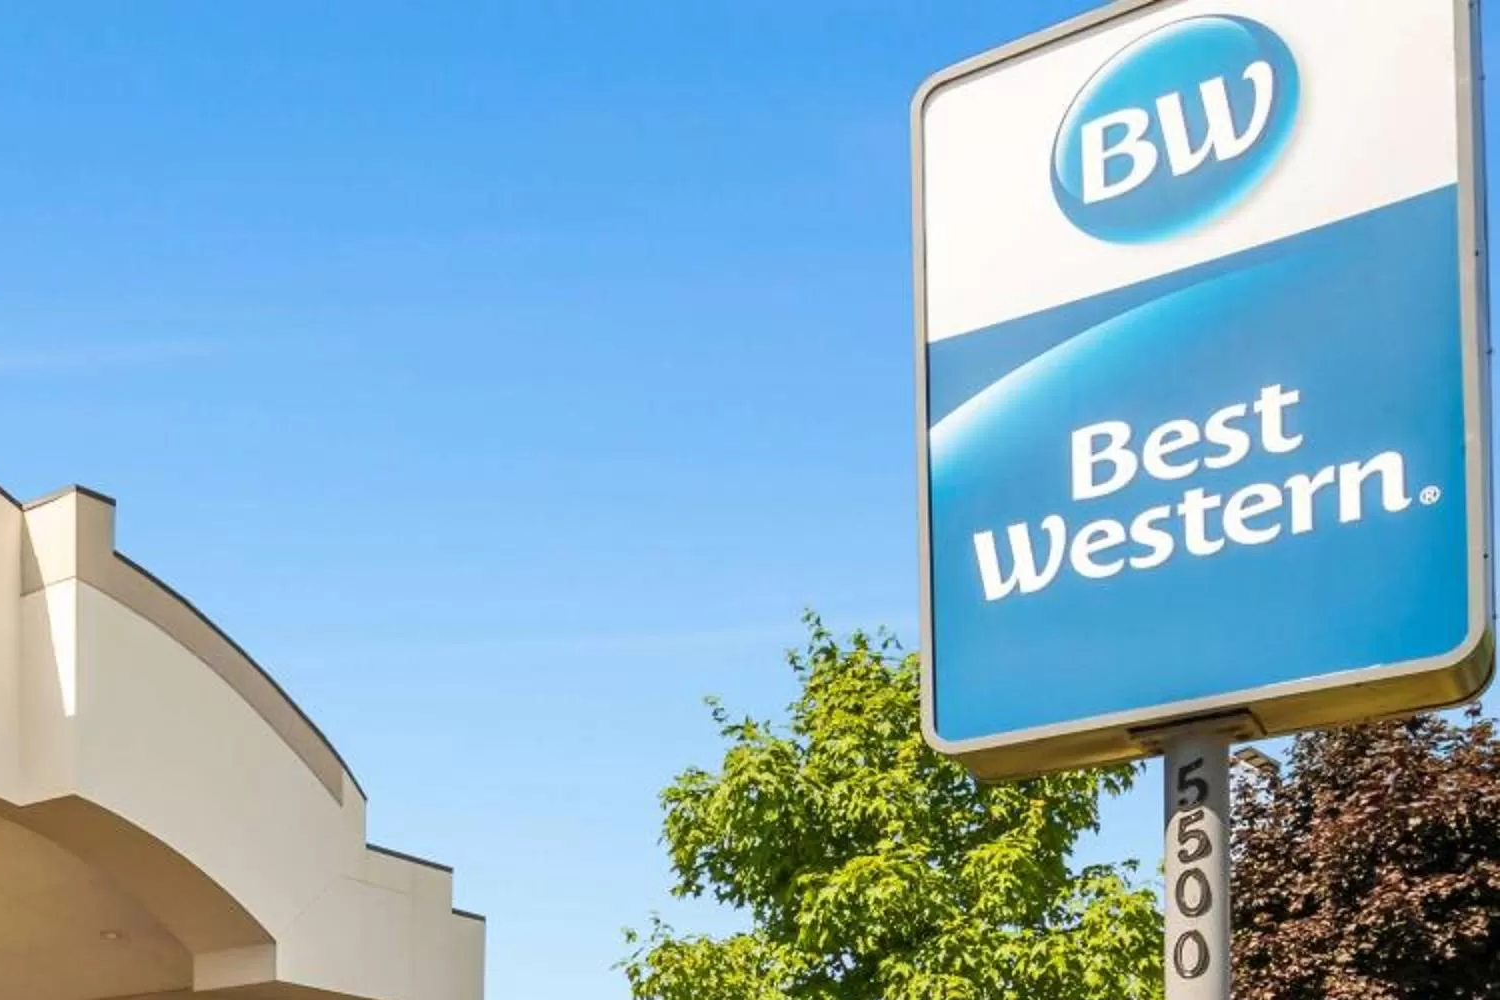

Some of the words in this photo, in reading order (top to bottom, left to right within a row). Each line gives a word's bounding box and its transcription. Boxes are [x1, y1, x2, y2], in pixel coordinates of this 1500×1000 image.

[1080, 60, 1274, 205] BW
[1071, 383, 1303, 501] Best
[1174, 757, 1212, 980] 5500
